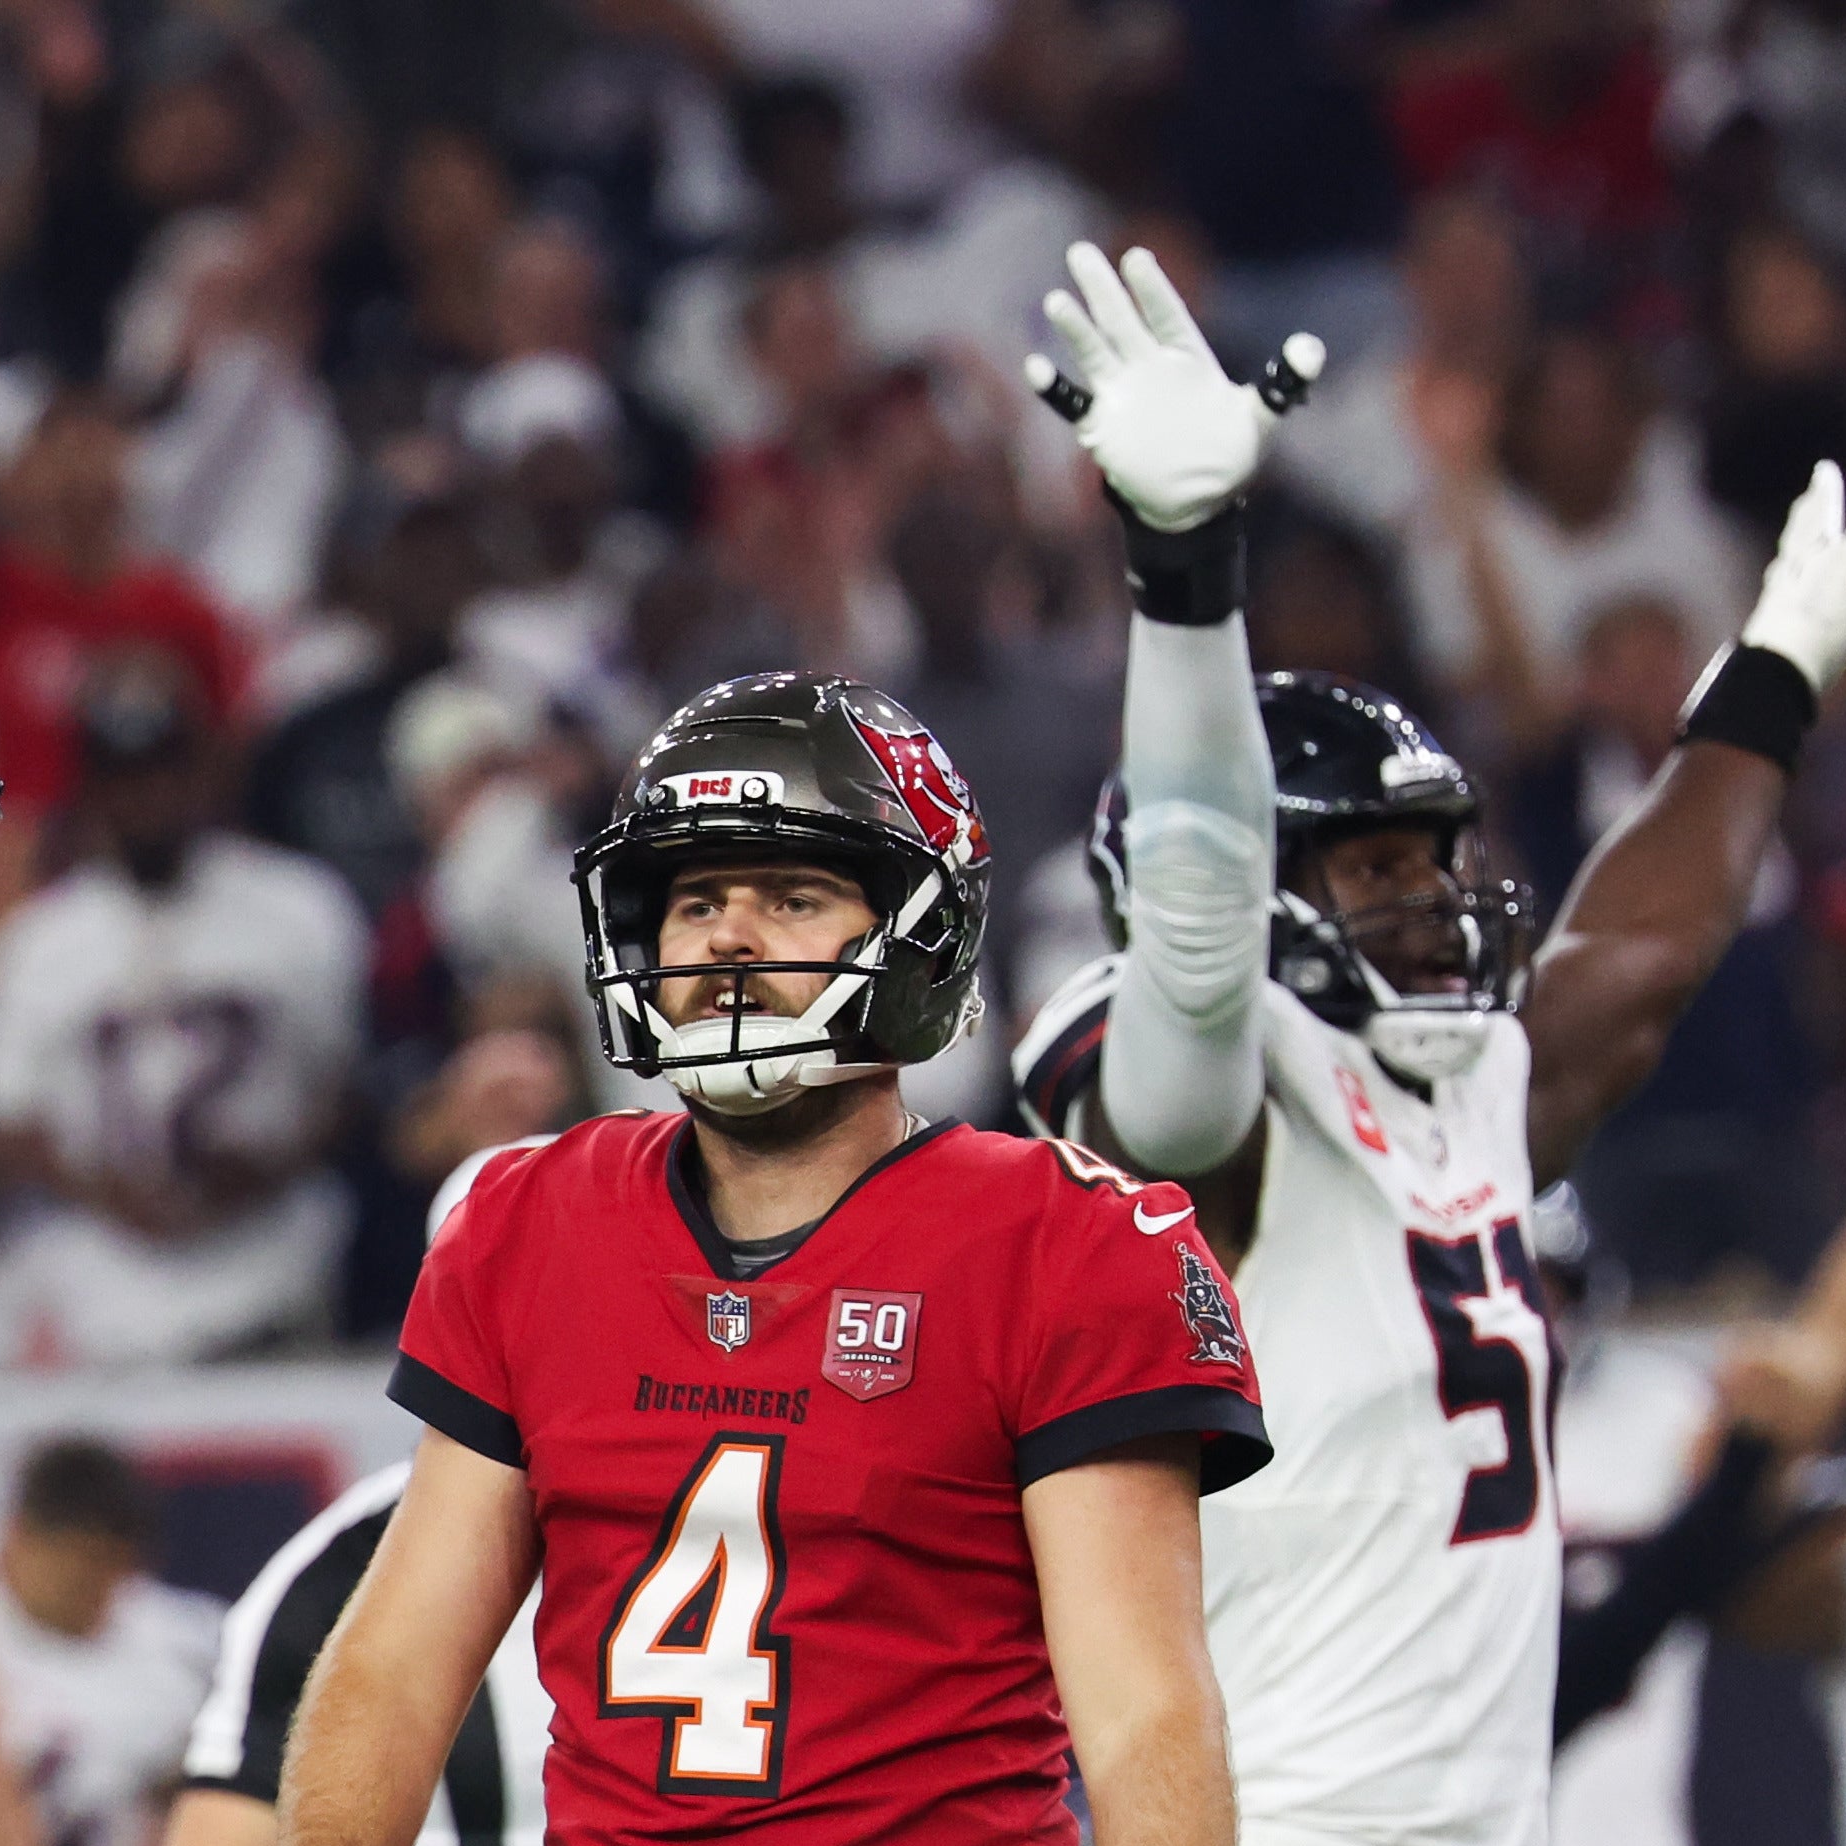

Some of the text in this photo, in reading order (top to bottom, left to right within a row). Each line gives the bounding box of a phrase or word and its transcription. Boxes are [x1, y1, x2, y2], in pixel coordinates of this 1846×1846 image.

[687, 776, 732, 799] BUCS
[836, 1300, 907, 1352] 50
[843, 1353, 892, 1364] SEASONS
[634, 1373, 811, 1425] BUCCANEERS
[598, 1431, 791, 1799] 4
